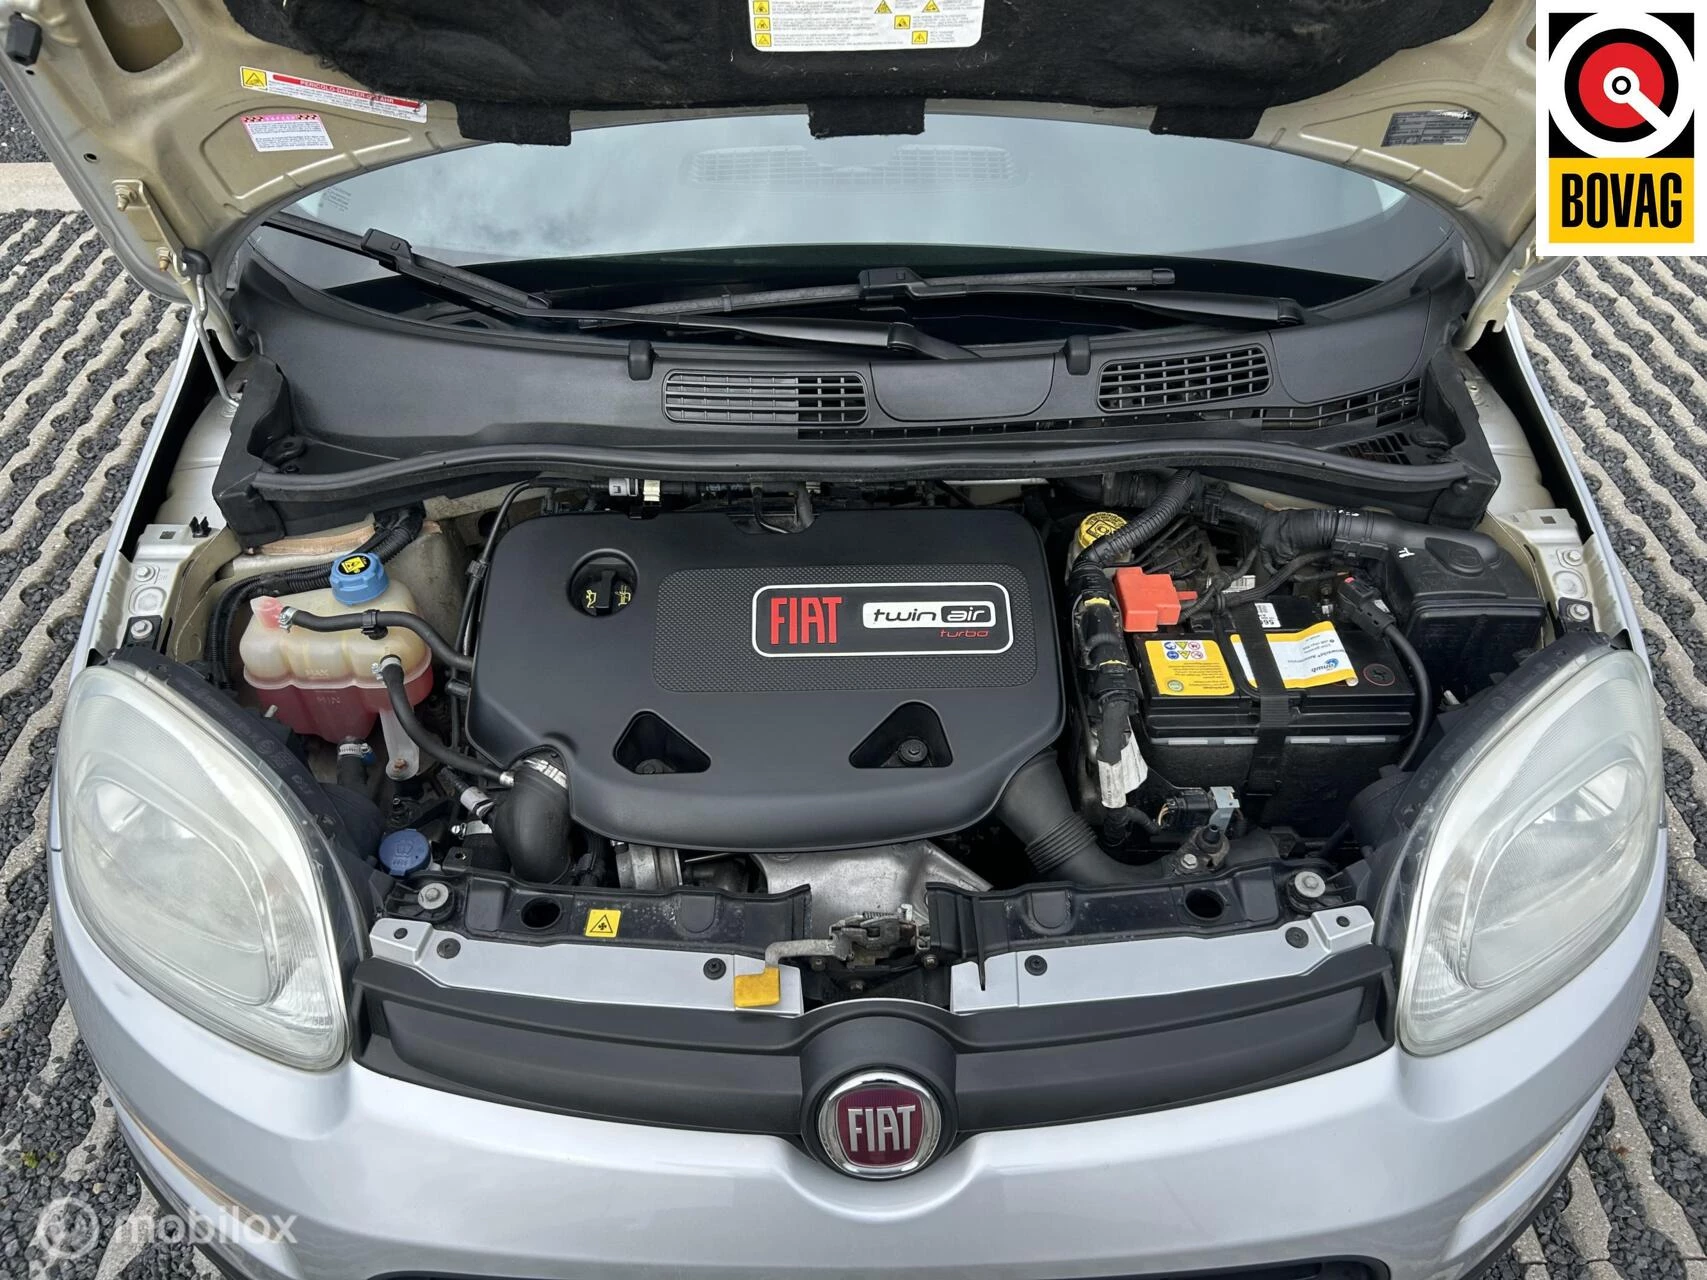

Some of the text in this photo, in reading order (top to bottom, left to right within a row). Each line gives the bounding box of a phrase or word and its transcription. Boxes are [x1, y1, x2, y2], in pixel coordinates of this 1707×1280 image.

[770, 596, 986, 645] FIAT twin air
[939, 629, 989, 638] turbo
[304, 668, 329, 677] MAX
[315, 696, 341, 704] MIN
[847, 1104, 916, 1152] FIAT
